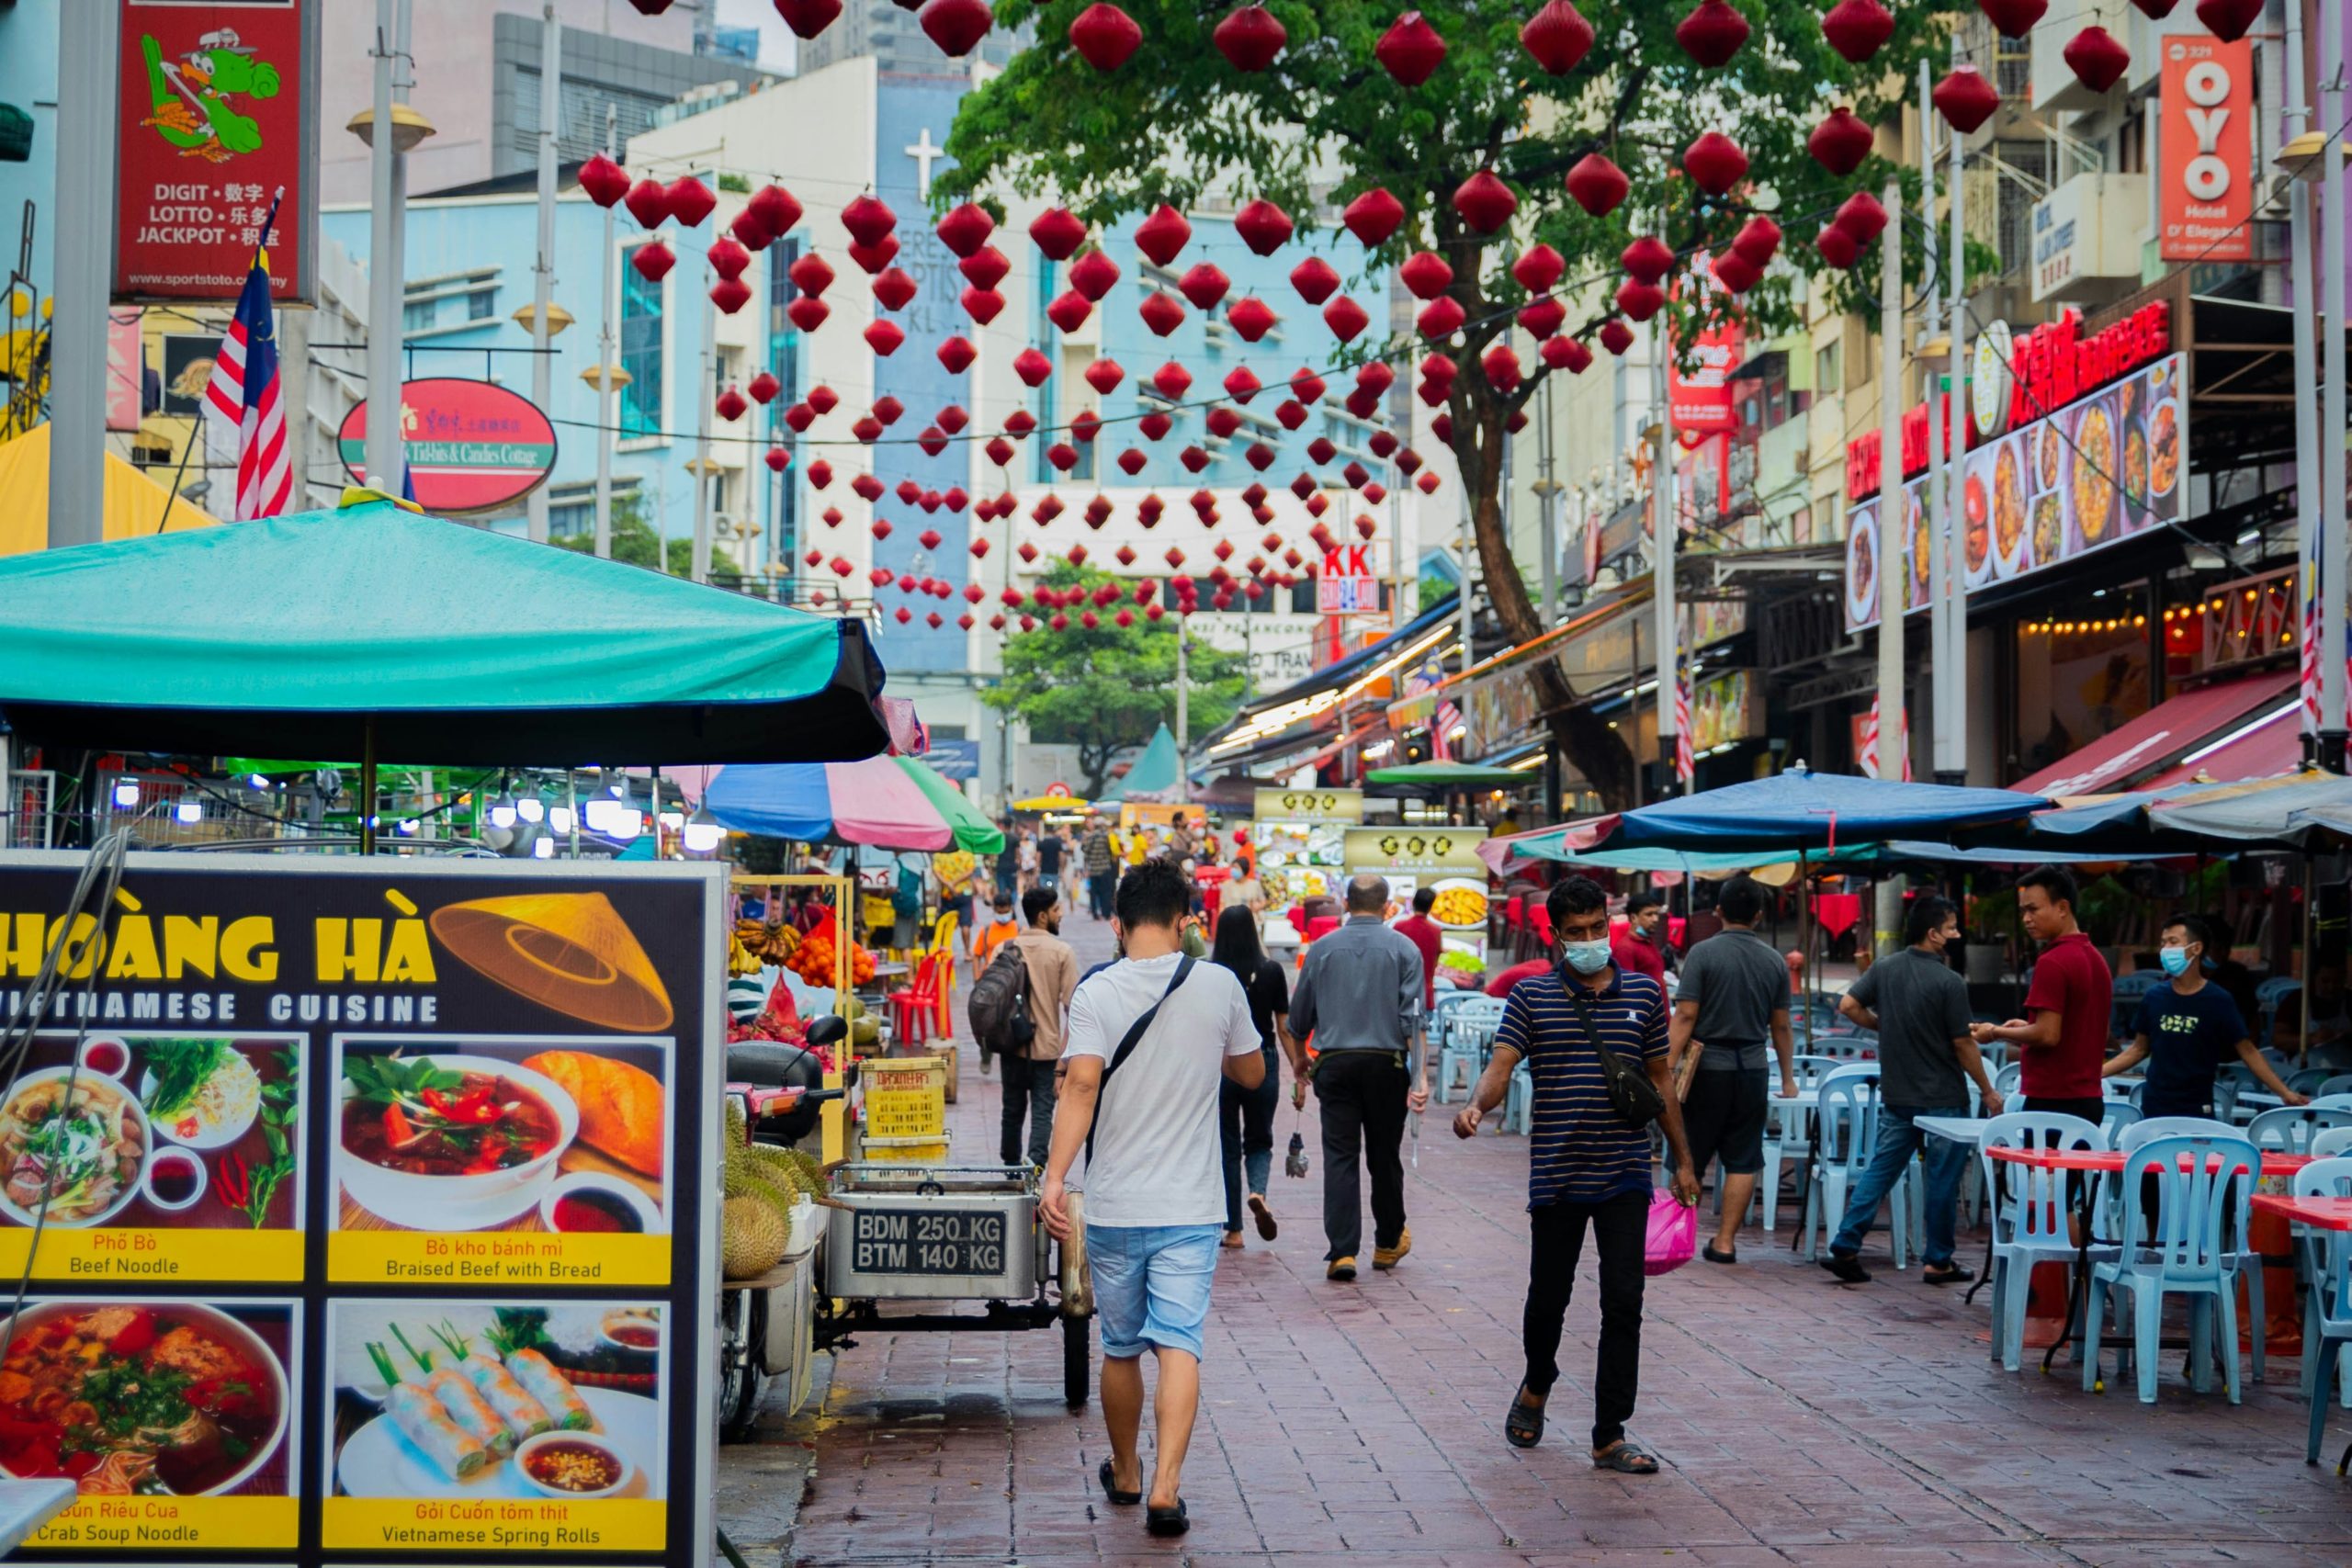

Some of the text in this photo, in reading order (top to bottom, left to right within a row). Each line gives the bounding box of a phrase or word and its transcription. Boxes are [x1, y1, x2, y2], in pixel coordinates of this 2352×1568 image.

[2184, 61, 2231, 201] OYO
[154, 184, 209, 201] DIGIT
[224, 183, 265, 203] 数字
[150, 206, 214, 223] LOTTO
[2185, 205, 2228, 220] Hotel
[137, 226, 225, 244] JACKPOT
[129, 273, 288, 290] www.sportstoto.comy
[909, 305, 937, 333] KL
[460, 442, 500, 464] Candies
[501, 443, 537, 468] Cottage
[1323, 544, 1370, 576] KK
[316, 887, 437, 983] HÀ
[0, 990, 437, 1022] IETNAMESE CUISINE
[858, 1214, 1001, 1242] BDM 250 KG
[133, 1232, 156, 1250] Bò
[426, 1238, 562, 1256] Bò kho bánh mì
[857, 1242, 1000, 1269] BTM 140 KG
[70, 1258, 179, 1274] Beef Noodle
[386, 1259, 602, 1278] Braised Beef with Bread
[100, 1501, 139, 1518] Riêu
[145, 1503, 178, 1518] Cua
[500, 1503, 534, 1520] tôm
[38, 1525, 199, 1544] Crab Soup Noodle
[382, 1526, 601, 1547] Vietnamese Spring Rolls
